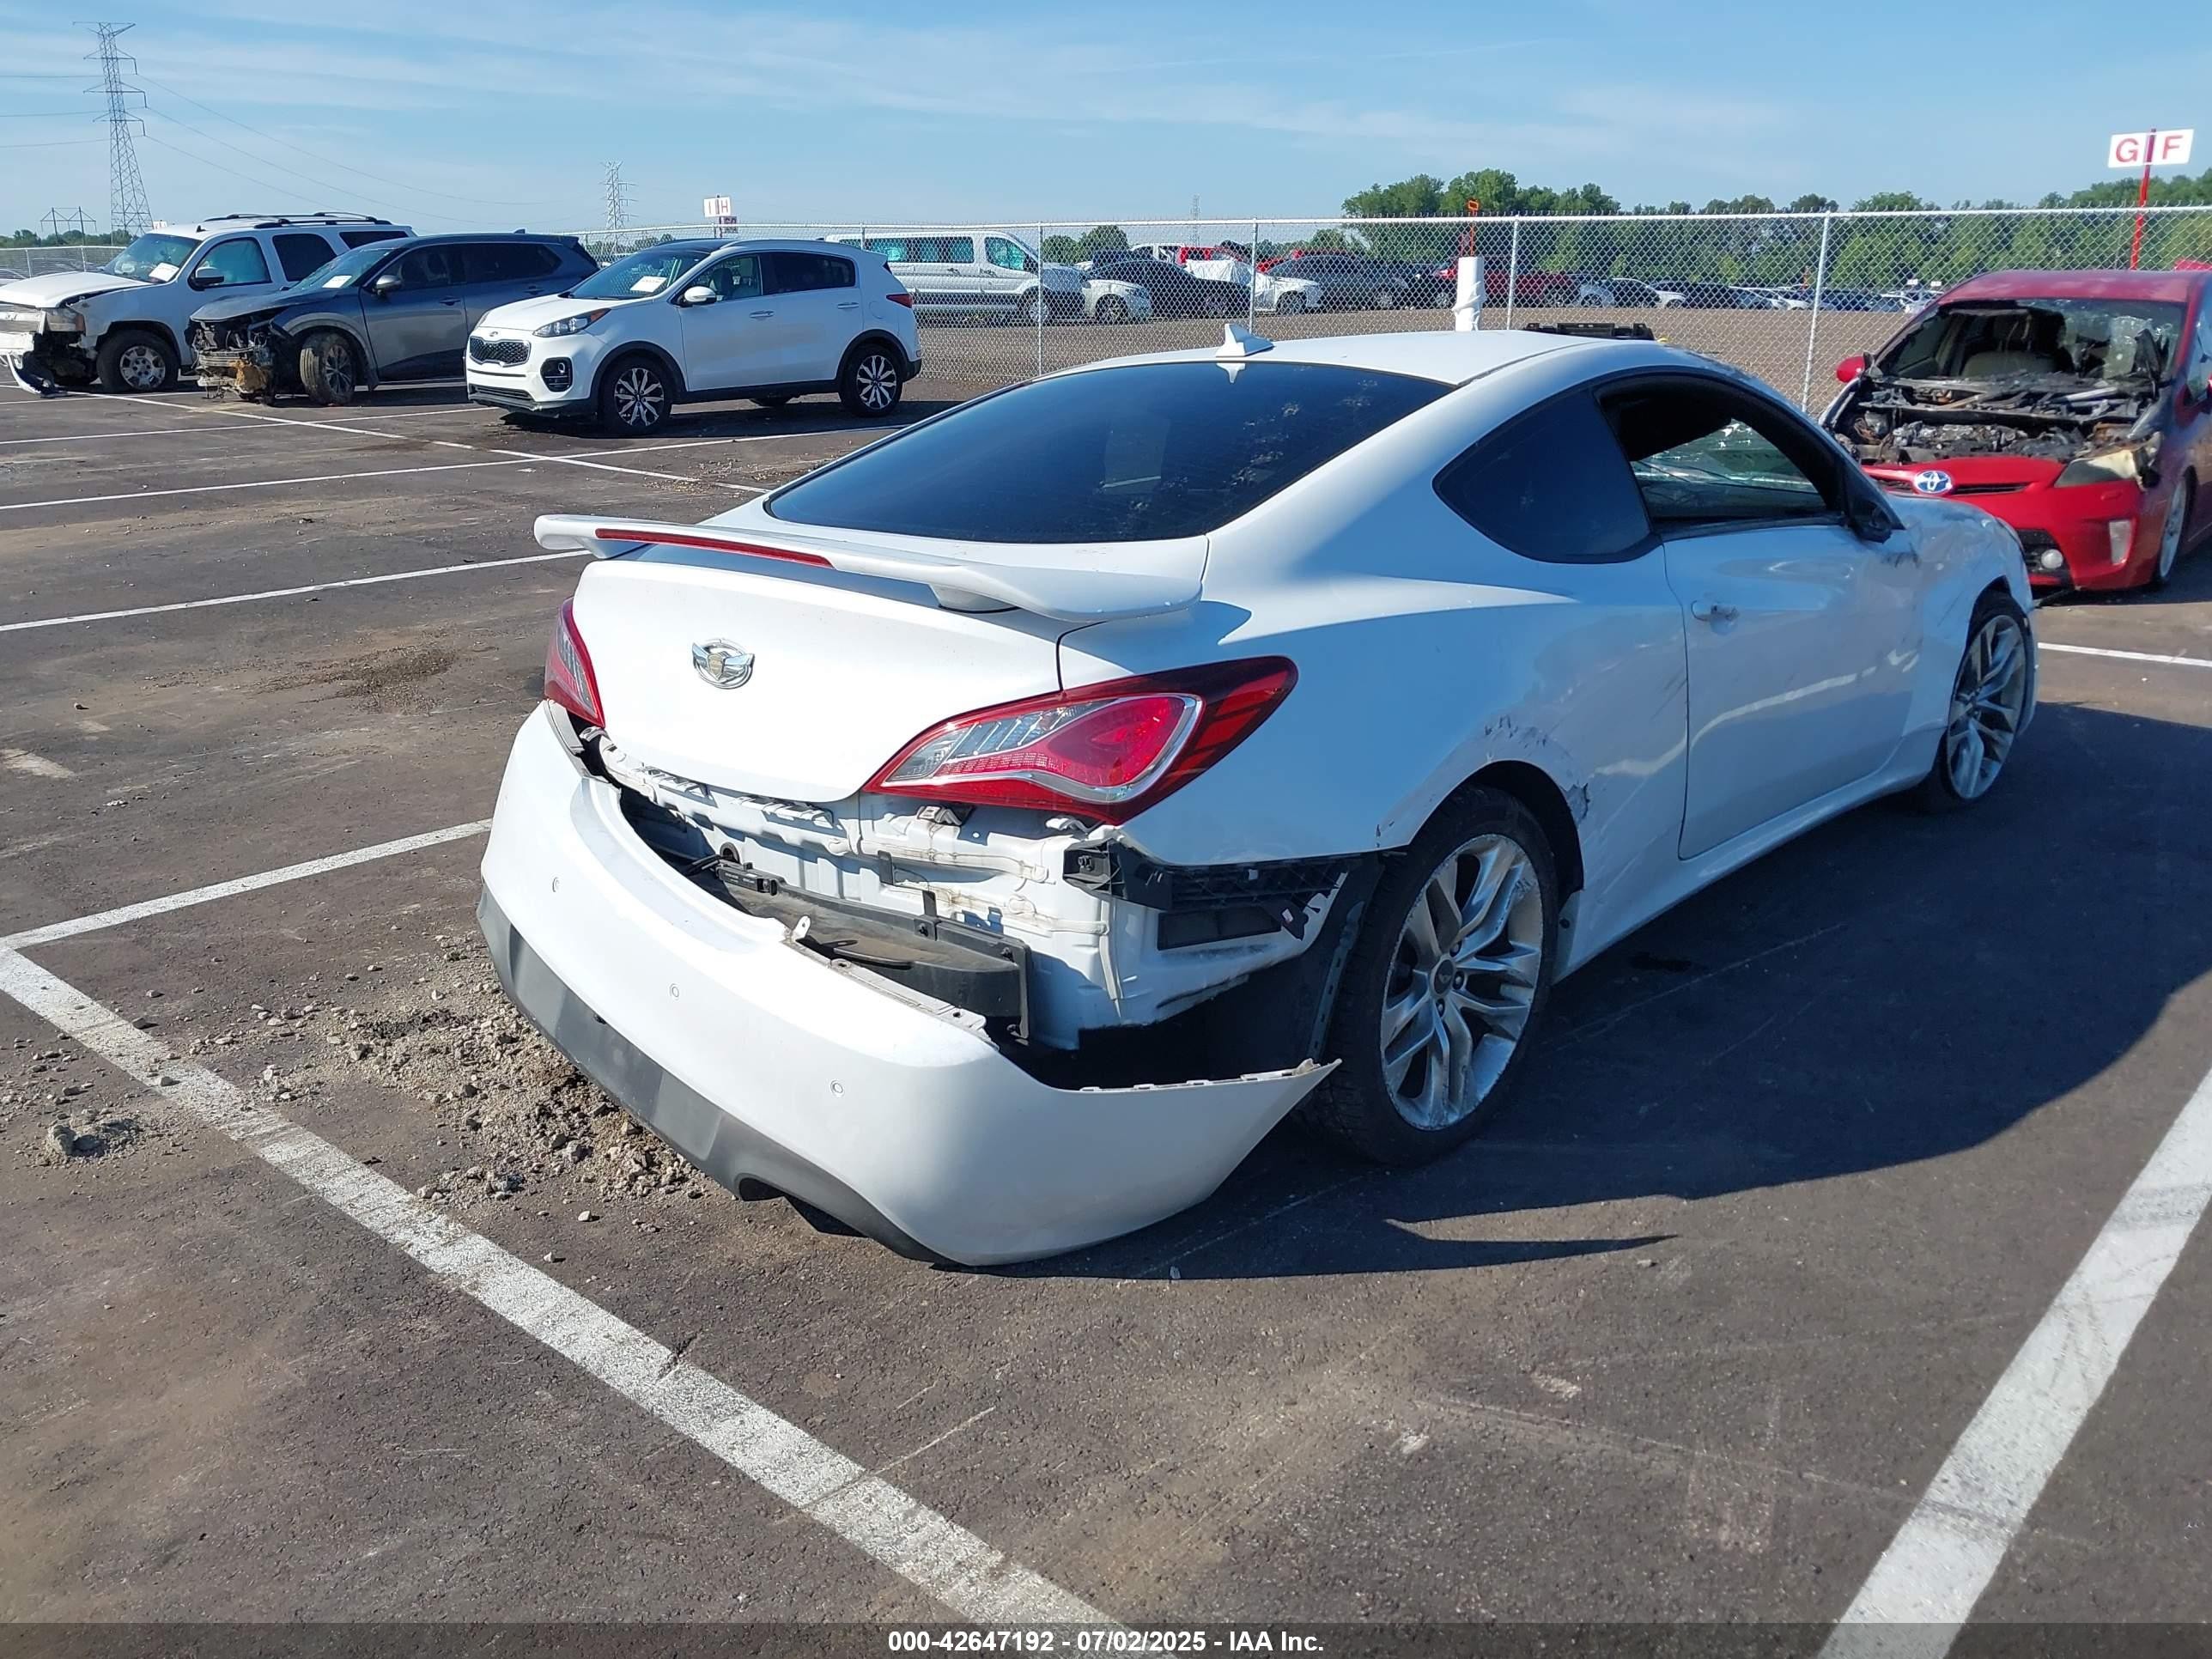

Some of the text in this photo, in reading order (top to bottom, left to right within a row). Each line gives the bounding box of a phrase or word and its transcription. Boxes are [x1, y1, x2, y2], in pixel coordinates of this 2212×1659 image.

[2115, 135, 2184, 162] G F
[720, 198, 729, 214] H
